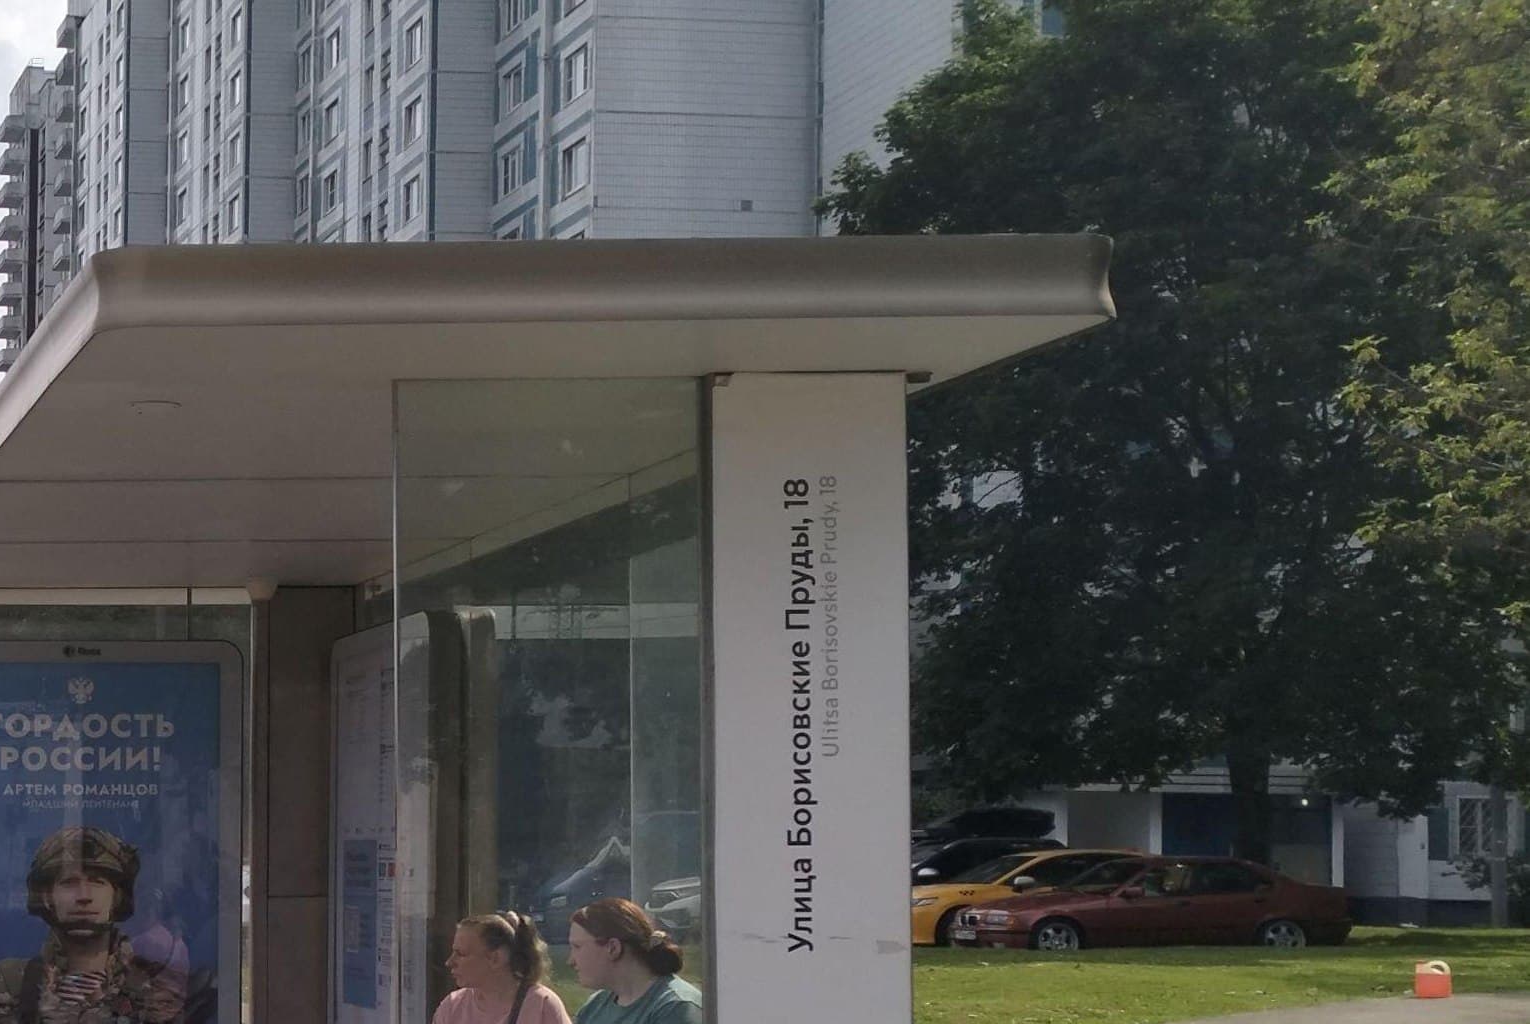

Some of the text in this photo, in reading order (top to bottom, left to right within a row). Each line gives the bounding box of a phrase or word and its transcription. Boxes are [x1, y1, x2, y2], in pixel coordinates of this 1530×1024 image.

[819, 475, 840, 757] Ulitsa Borisovskie Prudy, 18
[0, 746, 161, 772] РОССИИ!
[3, 783, 159, 798] АРТЕМ РОМАНЦОВ
[782, 478, 817, 953] Улица Борисовские Пруды, 18
